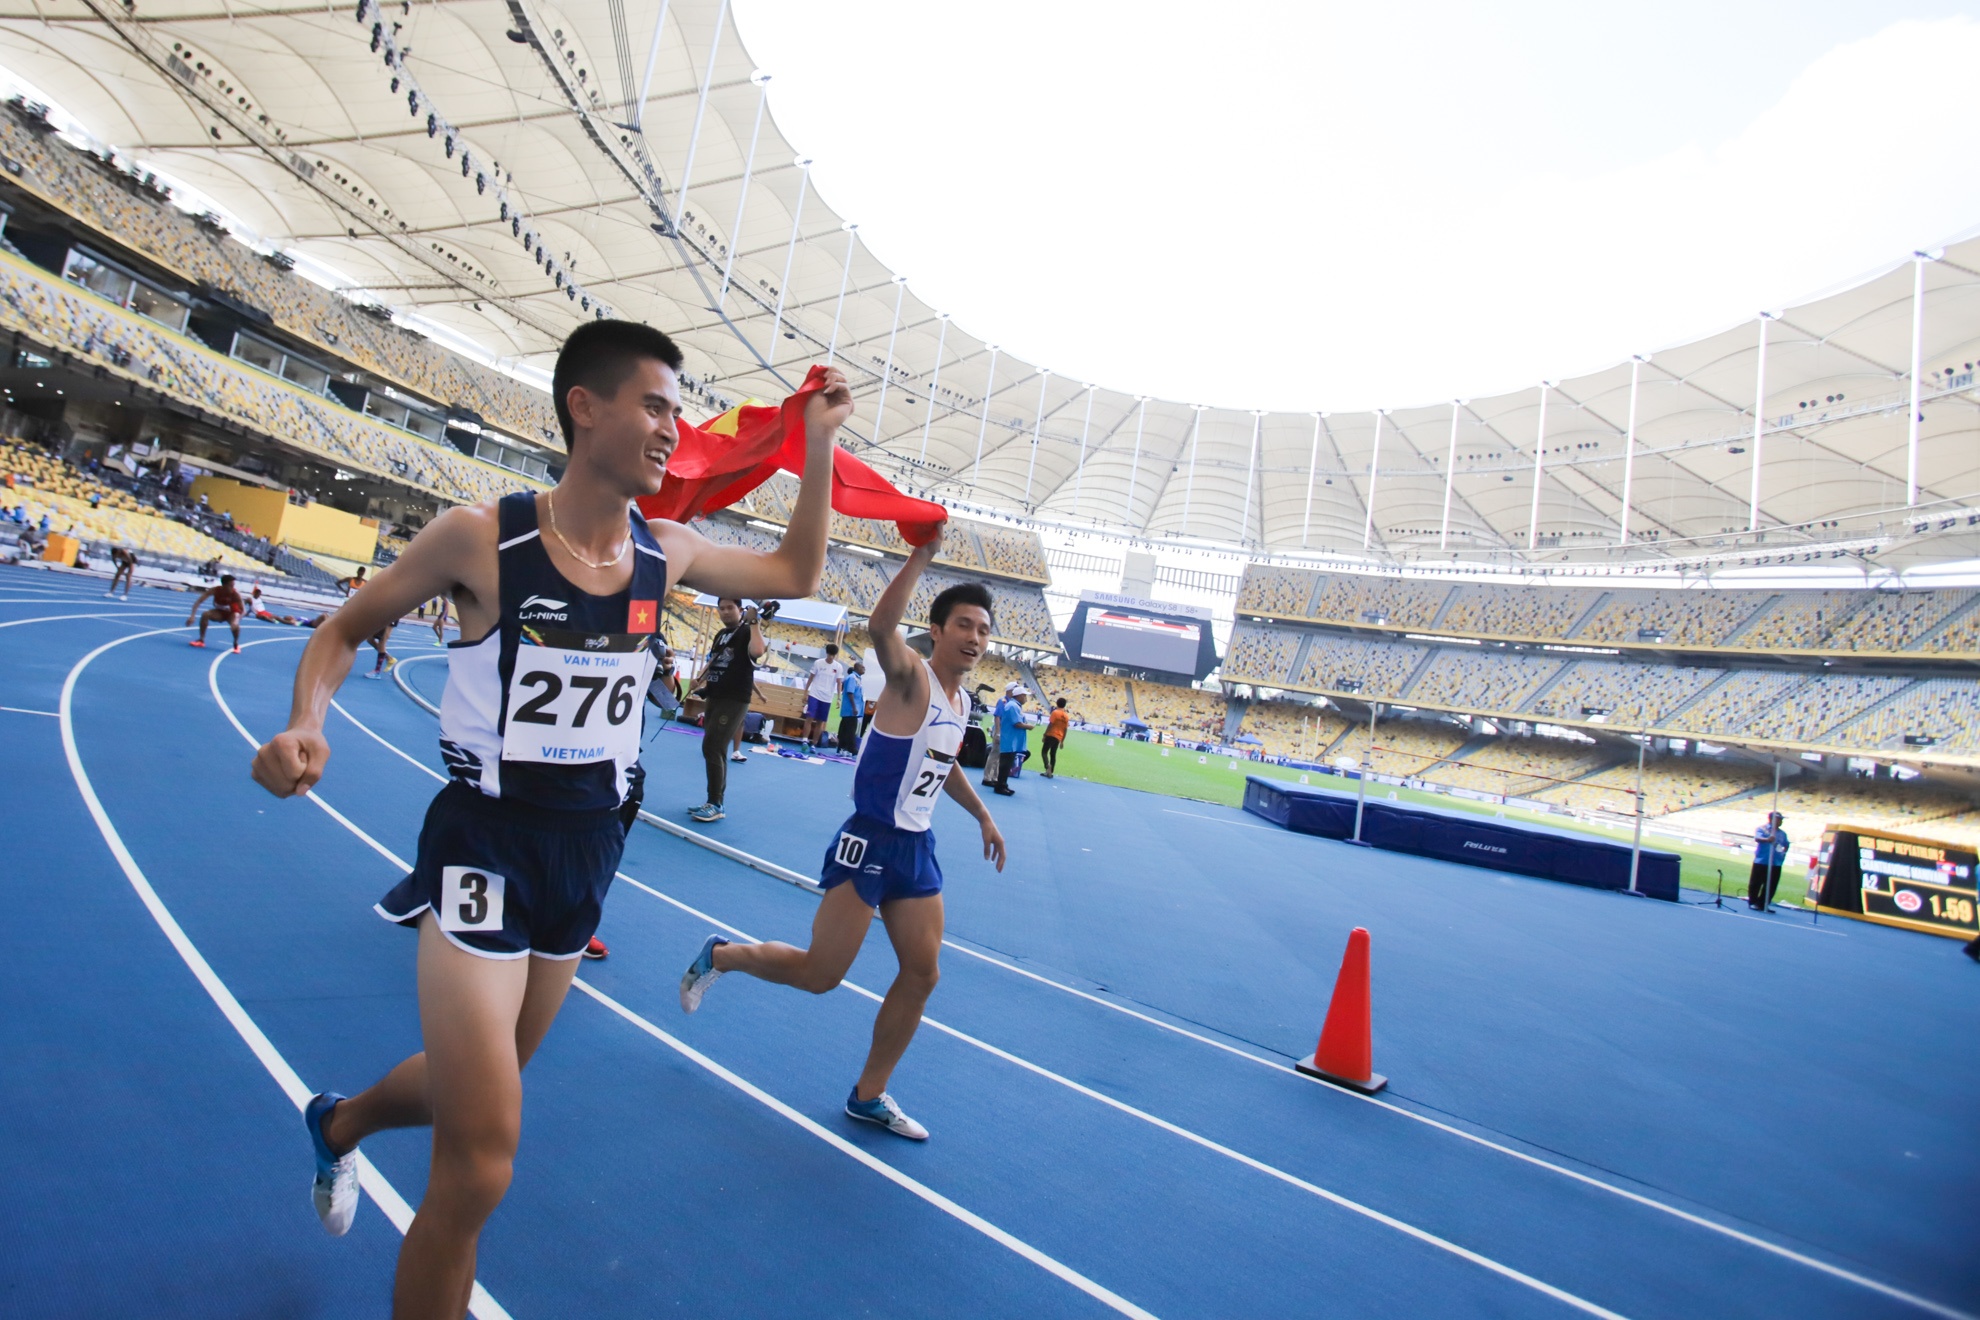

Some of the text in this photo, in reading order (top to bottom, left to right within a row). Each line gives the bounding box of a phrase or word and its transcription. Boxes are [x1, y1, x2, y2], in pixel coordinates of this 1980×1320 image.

[1094, 592, 1136, 605] SAMSUNG
[1138, 599, 1168, 612] Galaxy
[1168, 603, 1178, 611] S8
[518, 611, 568, 622] LI-NING
[563, 654, 620, 667] VAN THAI
[512, 670, 636, 728] 276
[541, 746, 605, 760] VIETNAM
[839, 837, 864, 865] 10
[1938, 850, 1946, 862] 2
[459, 872, 488, 925] 3
[1929, 895, 1974, 923] 1.59
